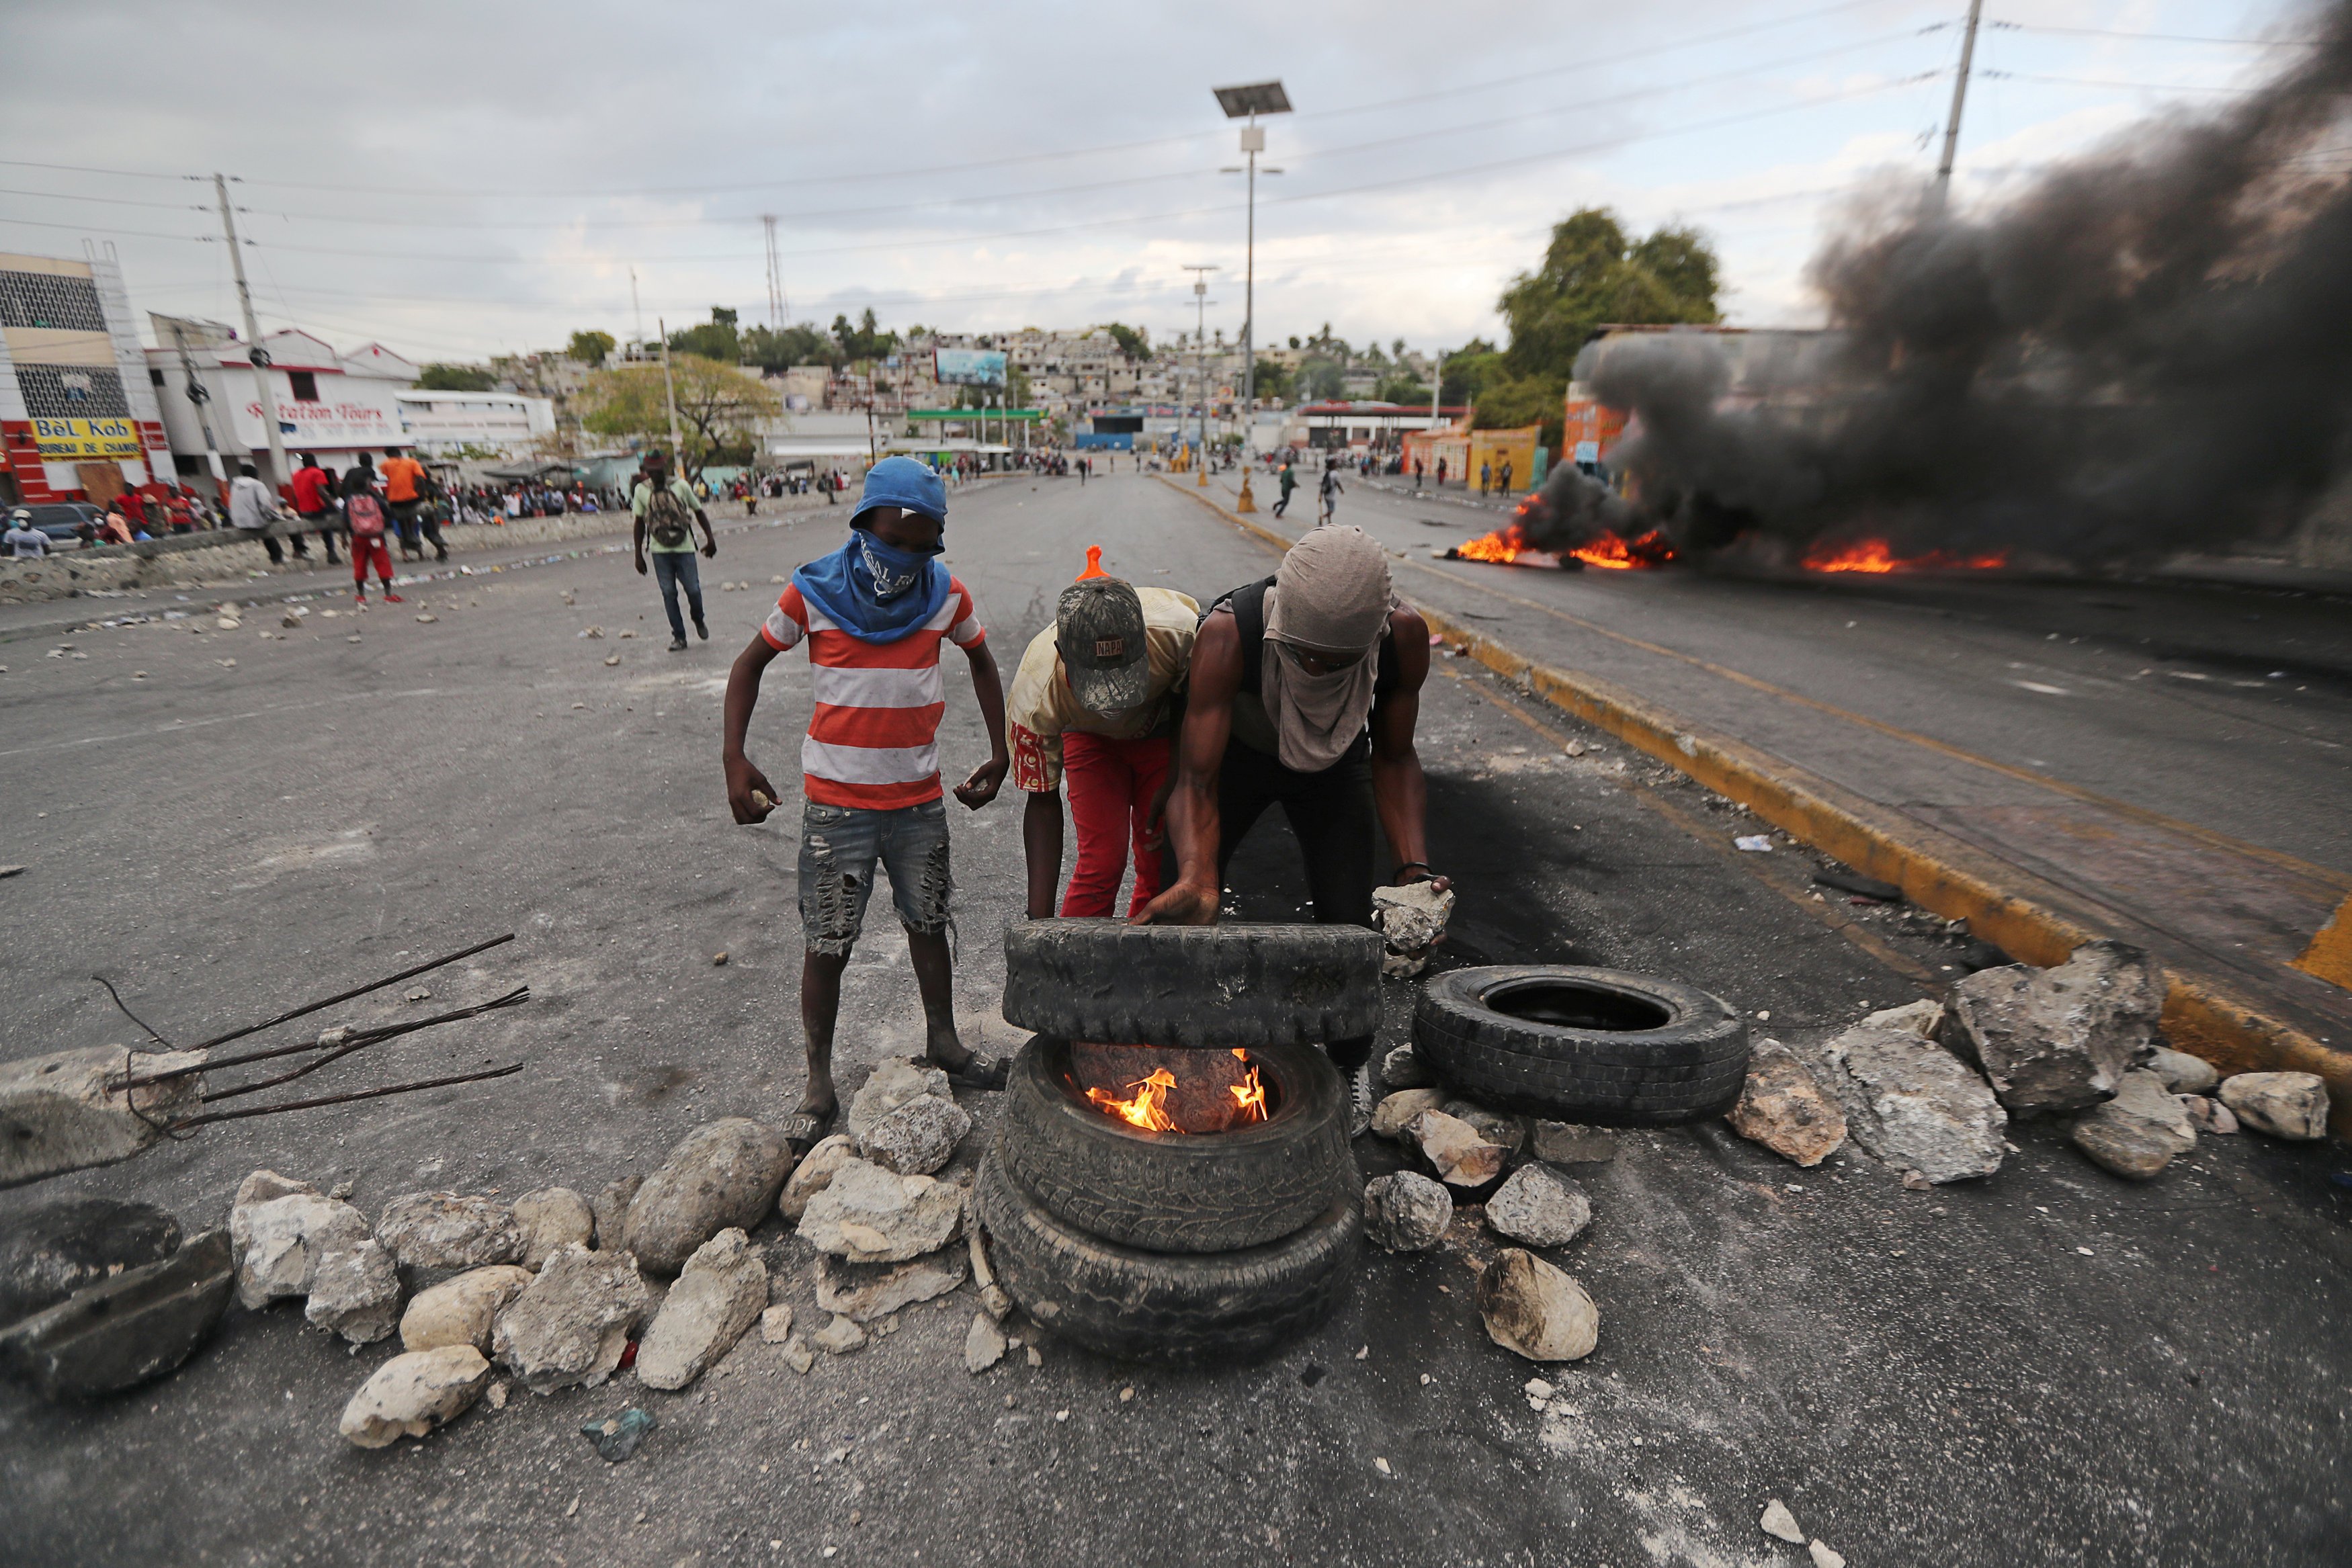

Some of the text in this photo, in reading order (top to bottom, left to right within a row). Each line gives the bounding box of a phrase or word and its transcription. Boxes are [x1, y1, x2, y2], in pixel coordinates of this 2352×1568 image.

[336, 402, 383, 419] Tours
[88, 419, 129, 436] Kob
[38, 443, 140, 453] BUREAU DE CHANGE
[1097, 640, 1123, 656] NAPA
